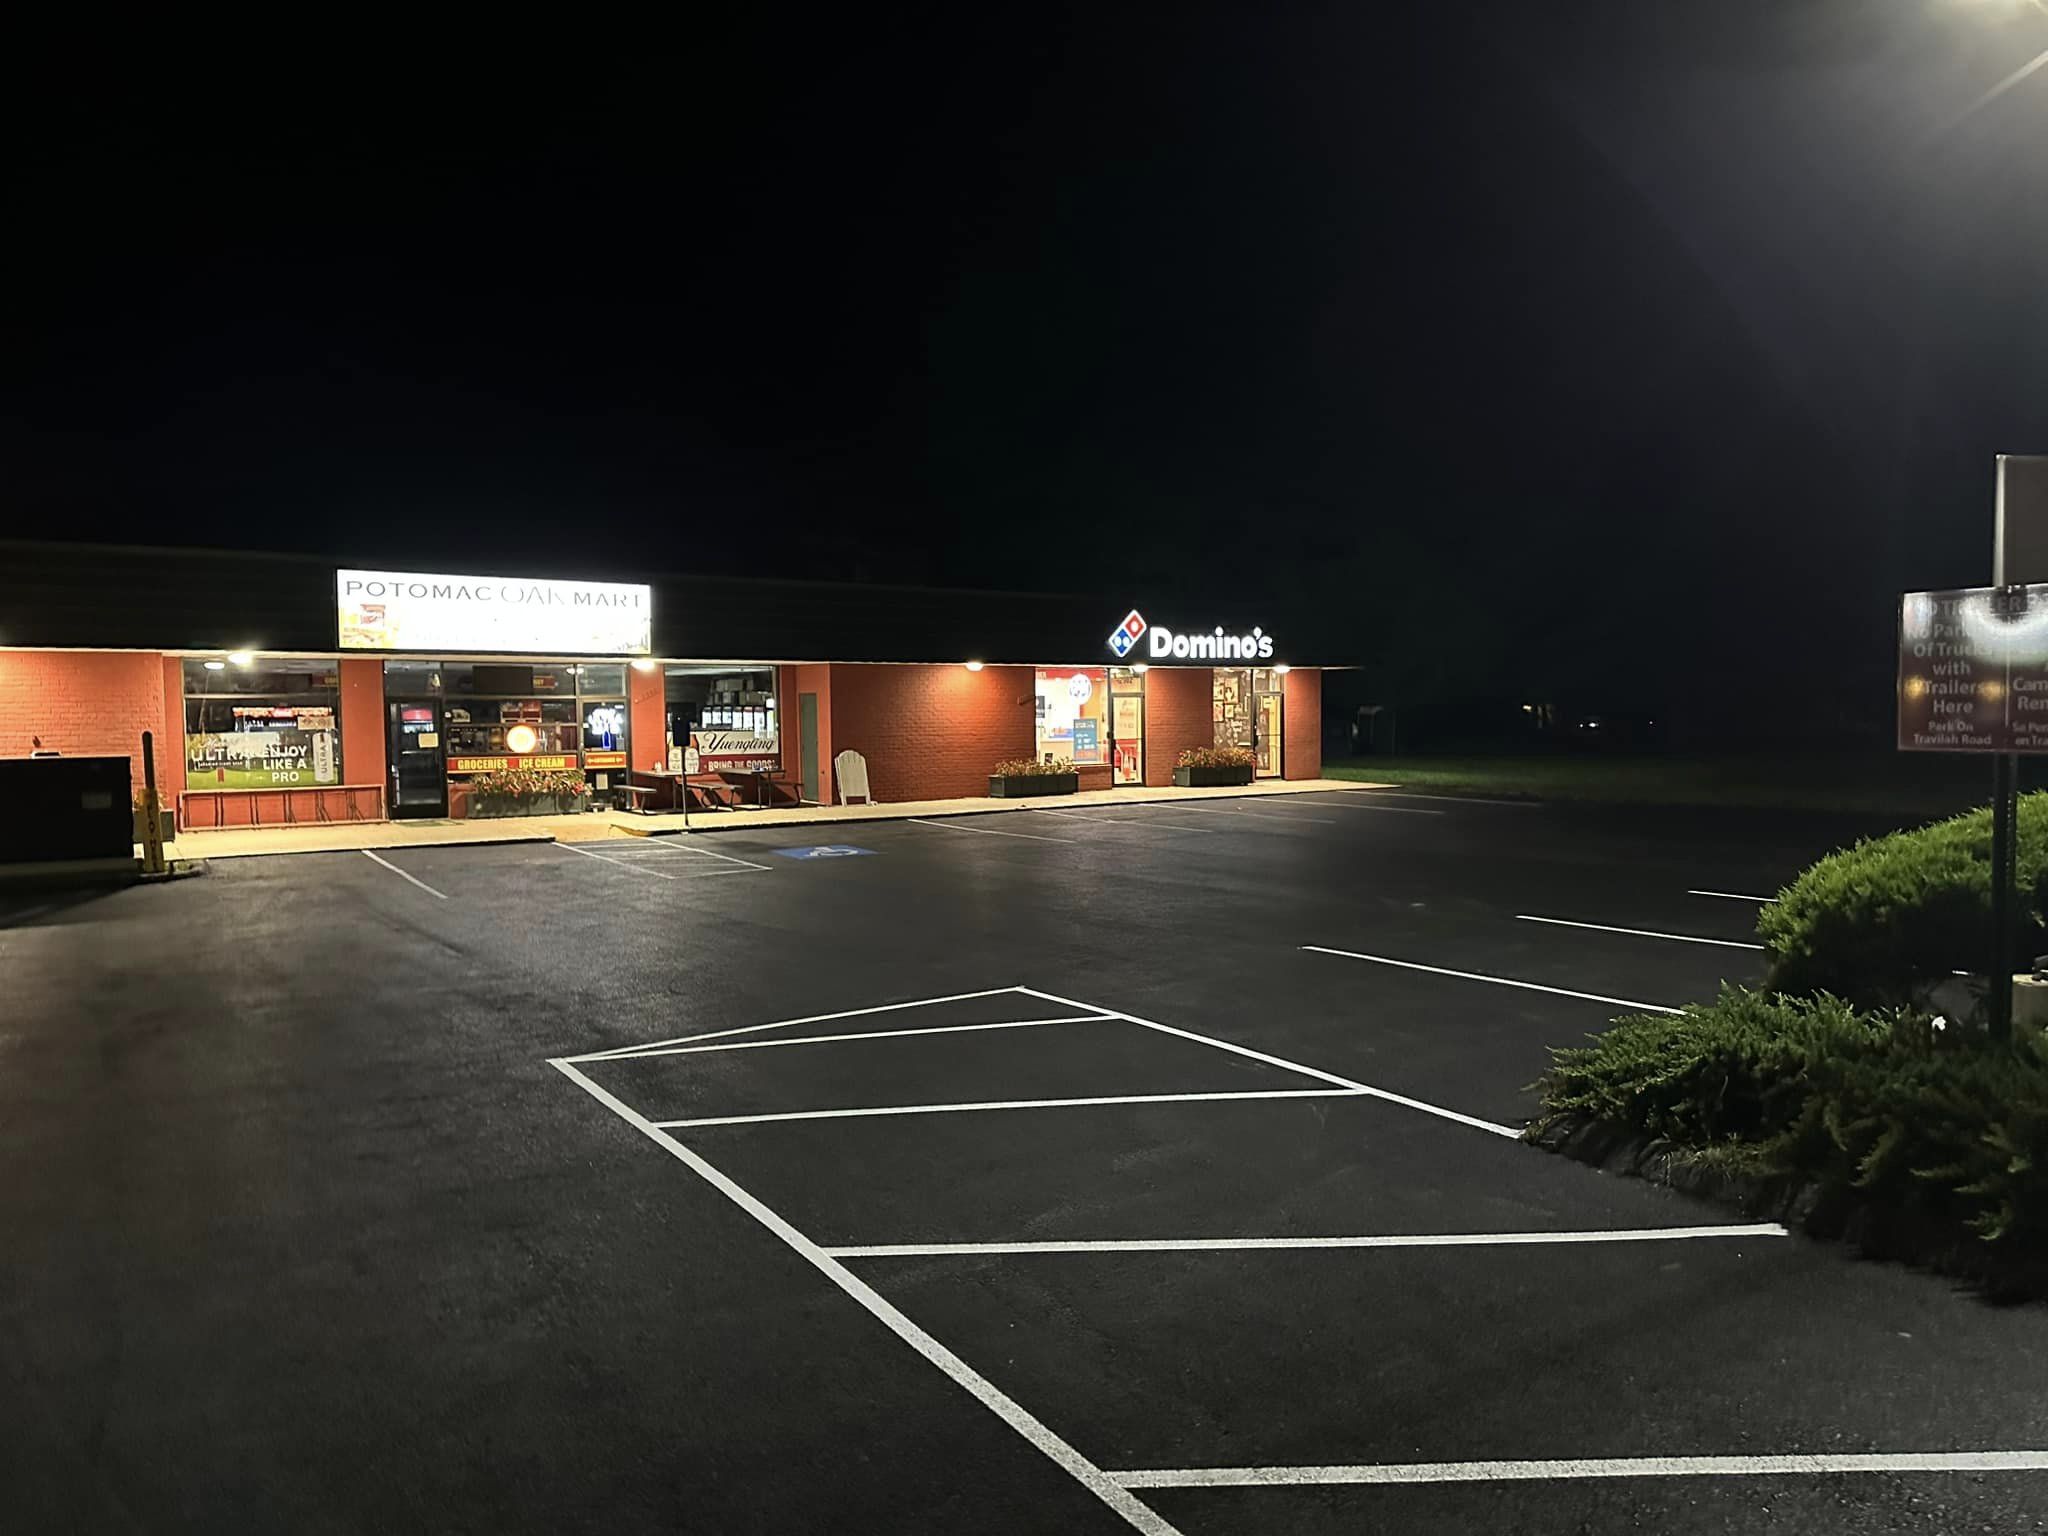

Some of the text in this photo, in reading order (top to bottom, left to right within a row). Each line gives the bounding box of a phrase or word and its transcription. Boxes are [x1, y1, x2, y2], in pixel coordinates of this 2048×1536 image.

[346, 580, 640, 609] POTOMAC OAK MART
[1149, 625, 1275, 659] Domino's
[1913, 642, 1935, 657] Of
[1932, 660, 1971, 676] with
[1933, 698, 1974, 713] Here
[701, 731, 775, 754] Yuengling
[1961, 733, 1993, 745] Road
[263, 745, 307, 758] ENJOY
[263, 758, 307, 770] LIKE A
[319, 745, 328, 774] ULTRA
[457, 758, 508, 770] GROCERIES
[519, 757, 565, 769] ICE CREAM
[708, 760, 733, 772] BRING
[271, 771, 299, 783] PRO
